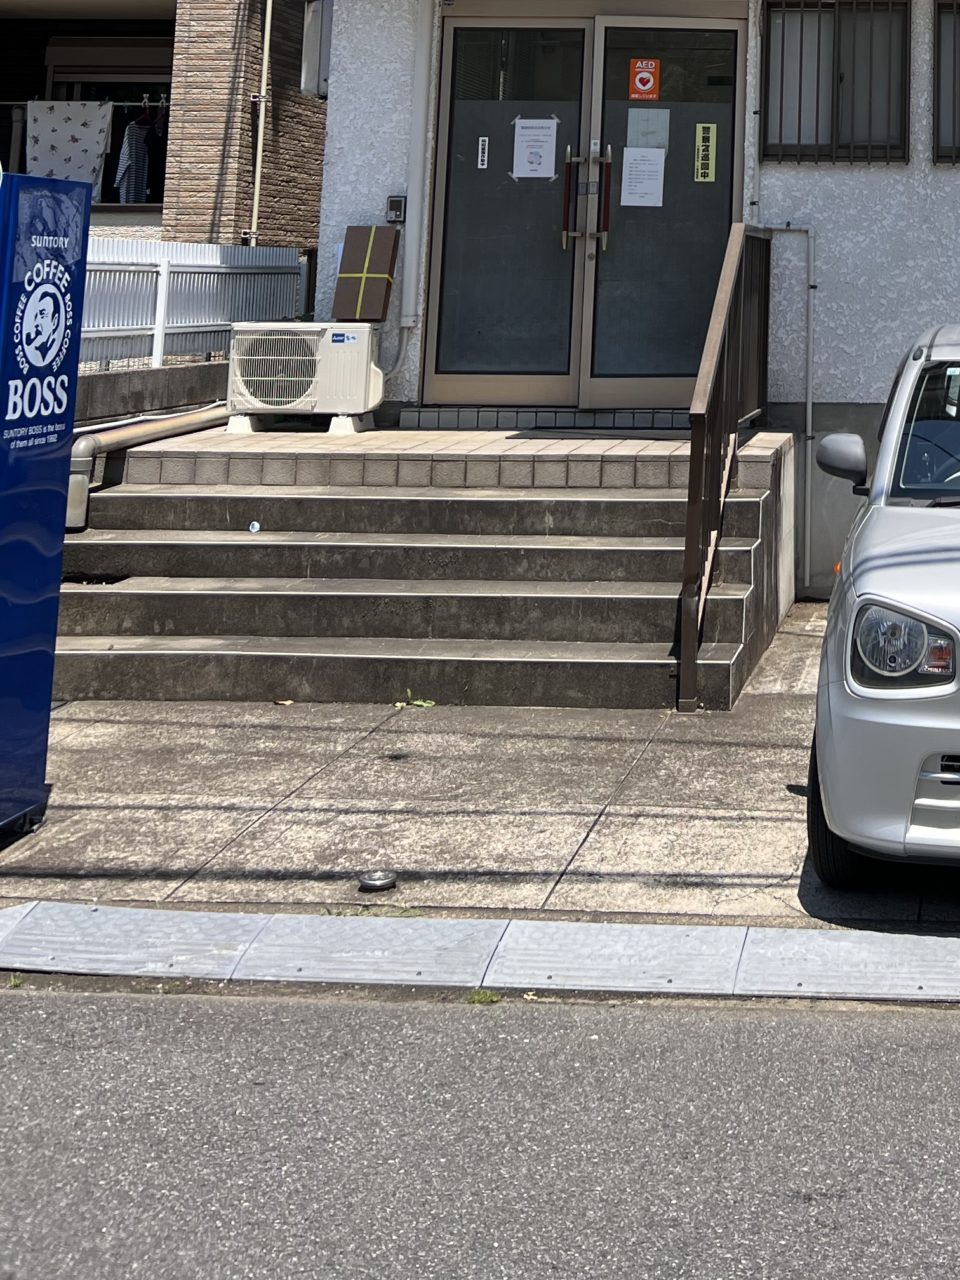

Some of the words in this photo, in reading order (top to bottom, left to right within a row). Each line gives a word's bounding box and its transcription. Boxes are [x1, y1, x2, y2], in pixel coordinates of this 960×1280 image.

[636, 60, 656, 69] AED
[24, 259, 71, 293] COFFEE
[13, 293, 28, 343] COFFEE
[64, 292, 73, 326] BOSS
[14, 344, 30, 375] BOSS
[51, 329, 72, 373] COFFEE
[5, 374, 69, 421] BOSS
[3, 427, 28, 439] SUNTORY
[28, 425, 43, 435] BOSS
[47, 424, 55, 432] the
[16, 439, 28, 448] them
